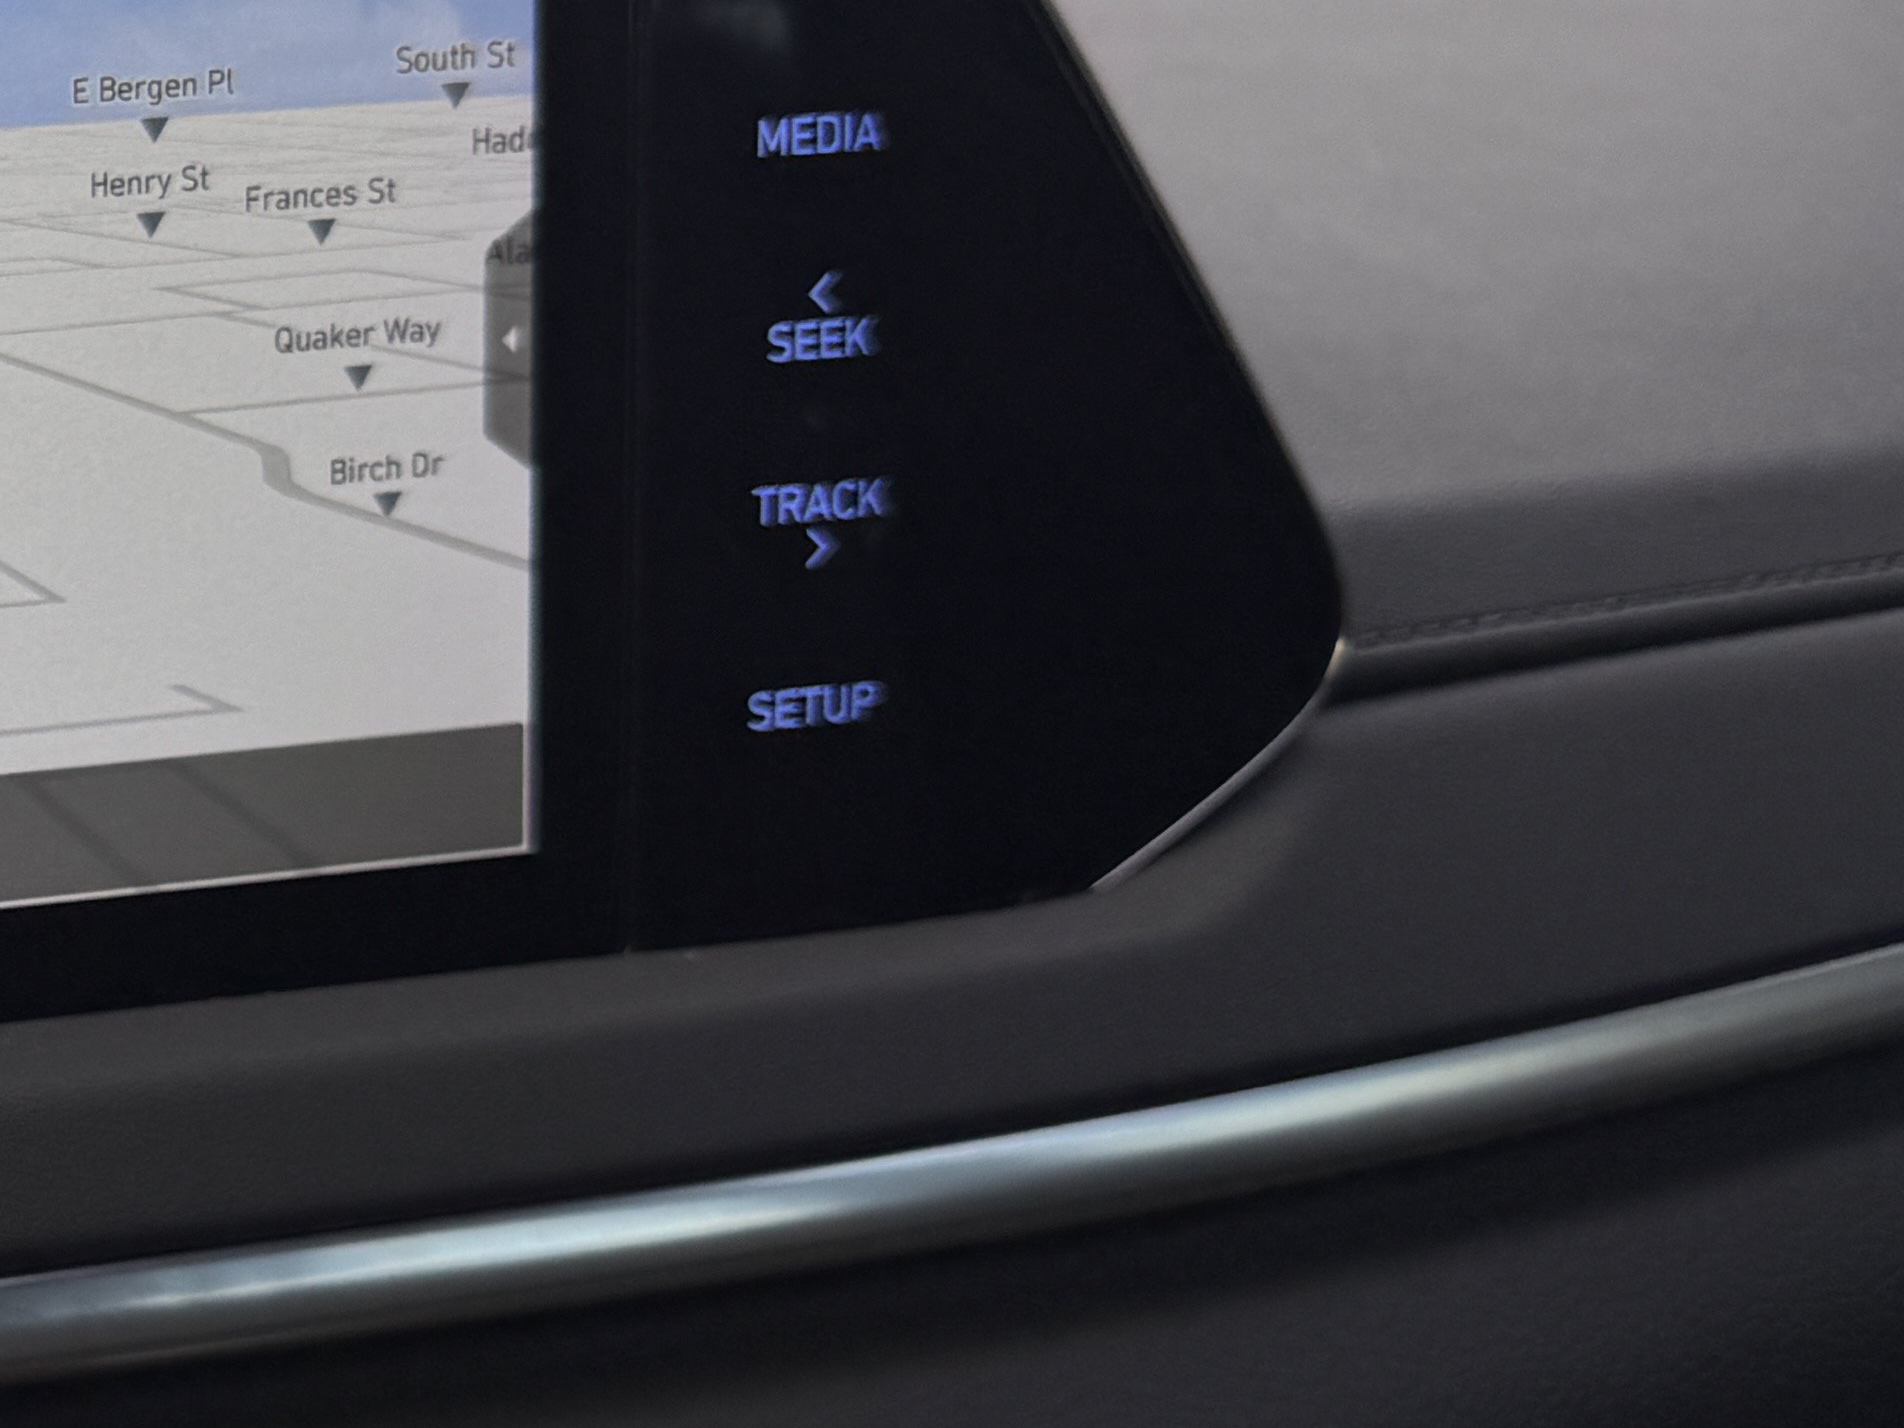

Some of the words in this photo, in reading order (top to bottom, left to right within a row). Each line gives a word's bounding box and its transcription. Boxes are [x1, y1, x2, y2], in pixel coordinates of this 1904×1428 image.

[396, 43, 478, 76] South
[487, 40, 517, 69] St
[73, 77, 91, 105] E
[101, 73, 199, 105] Bergen
[207, 68, 235, 97] Pl
[757, 111, 884, 158] MEDIA
[90, 170, 172, 205] Henry
[181, 166, 211, 195] St
[245, 180, 358, 213] Frances
[367, 177, 397, 207] St
[274, 322, 372, 355] Quaker
[384, 316, 442, 349] Way
[767, 316, 876, 364] SEEK
[330, 453, 400, 485] Birch
[412, 450, 444, 480] Dr
[752, 477, 888, 525] TRACK
[747, 681, 882, 731] SETUP
